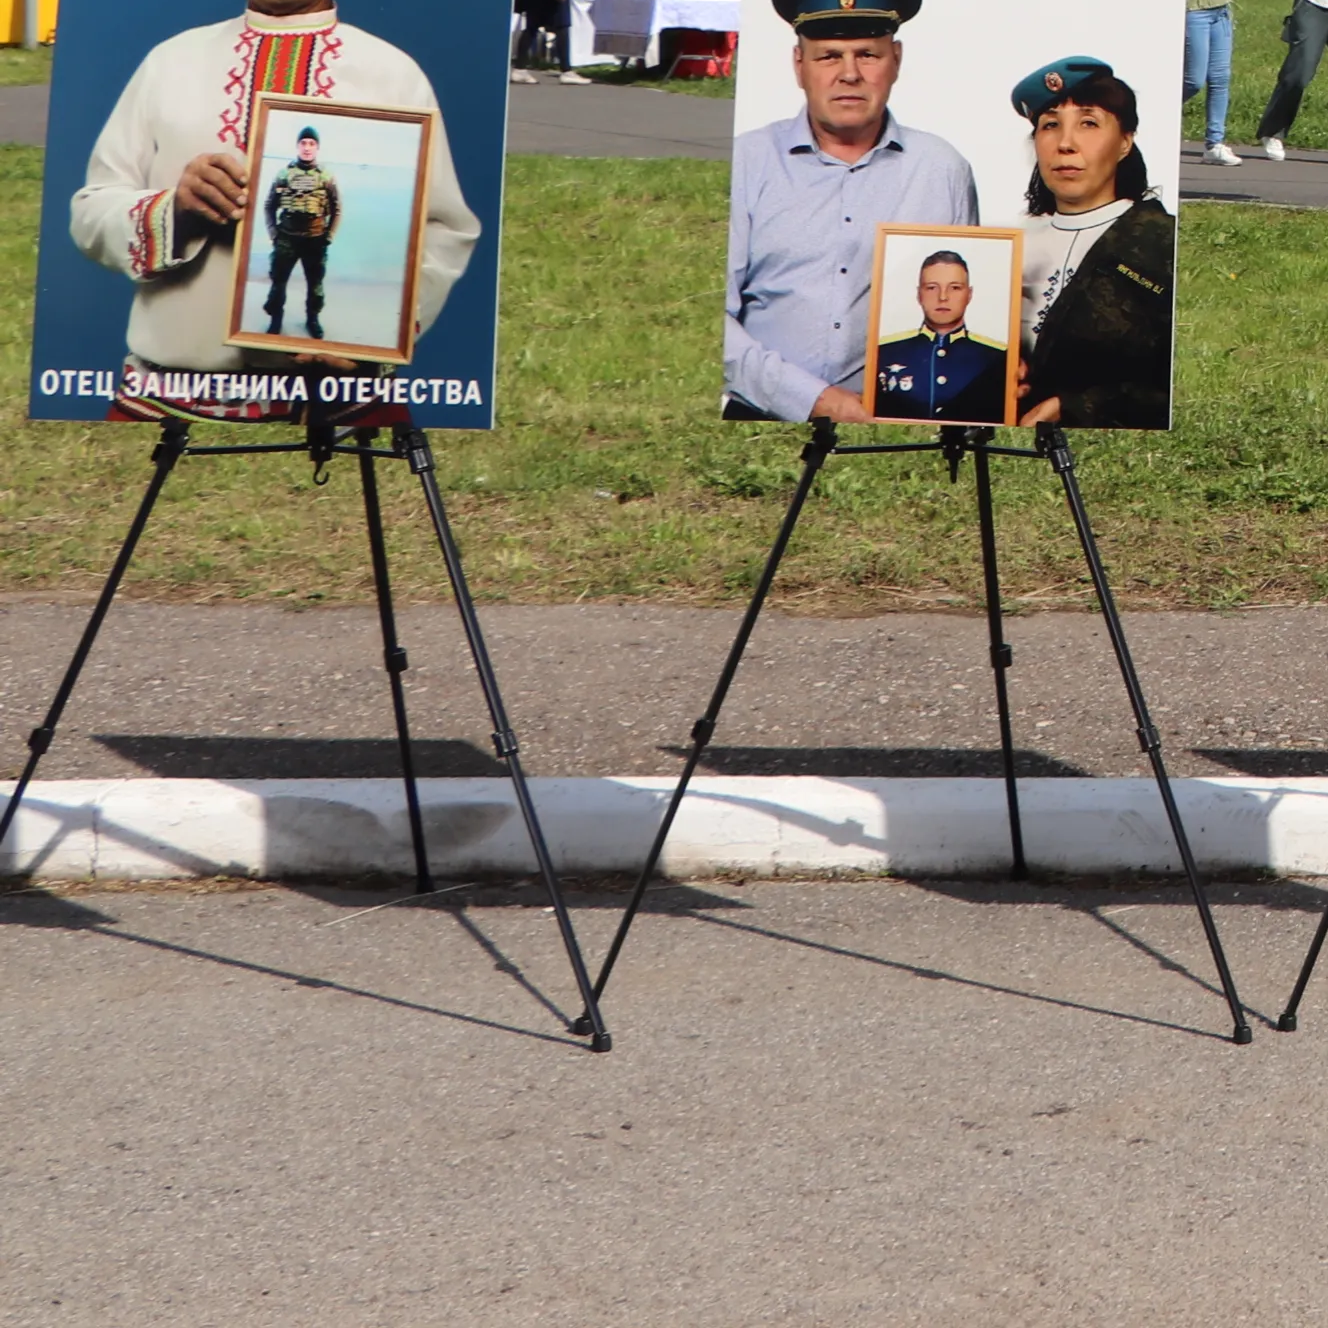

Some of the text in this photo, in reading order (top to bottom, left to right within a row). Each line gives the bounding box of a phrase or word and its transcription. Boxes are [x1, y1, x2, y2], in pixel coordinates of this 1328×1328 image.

[40, 369, 483, 406] ОТЕЦ ЗАЩИТНИКА ОТЕЧЕСТВА
